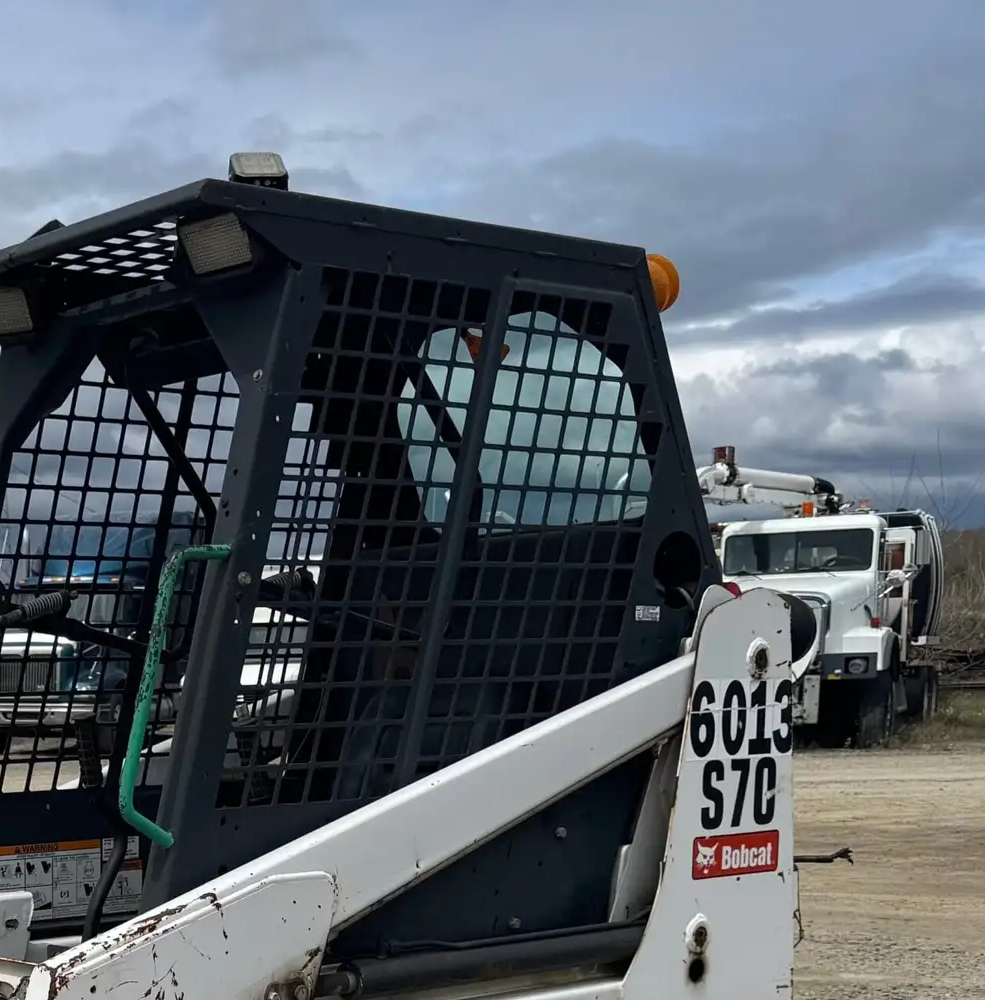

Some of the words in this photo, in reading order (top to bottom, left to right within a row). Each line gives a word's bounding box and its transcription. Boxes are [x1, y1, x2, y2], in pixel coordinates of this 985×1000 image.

[690, 679, 793, 758] 6013
[701, 756, 777, 830] S70
[22, 843, 59, 854] WARNING
[721, 842, 773, 870] Bobcat
